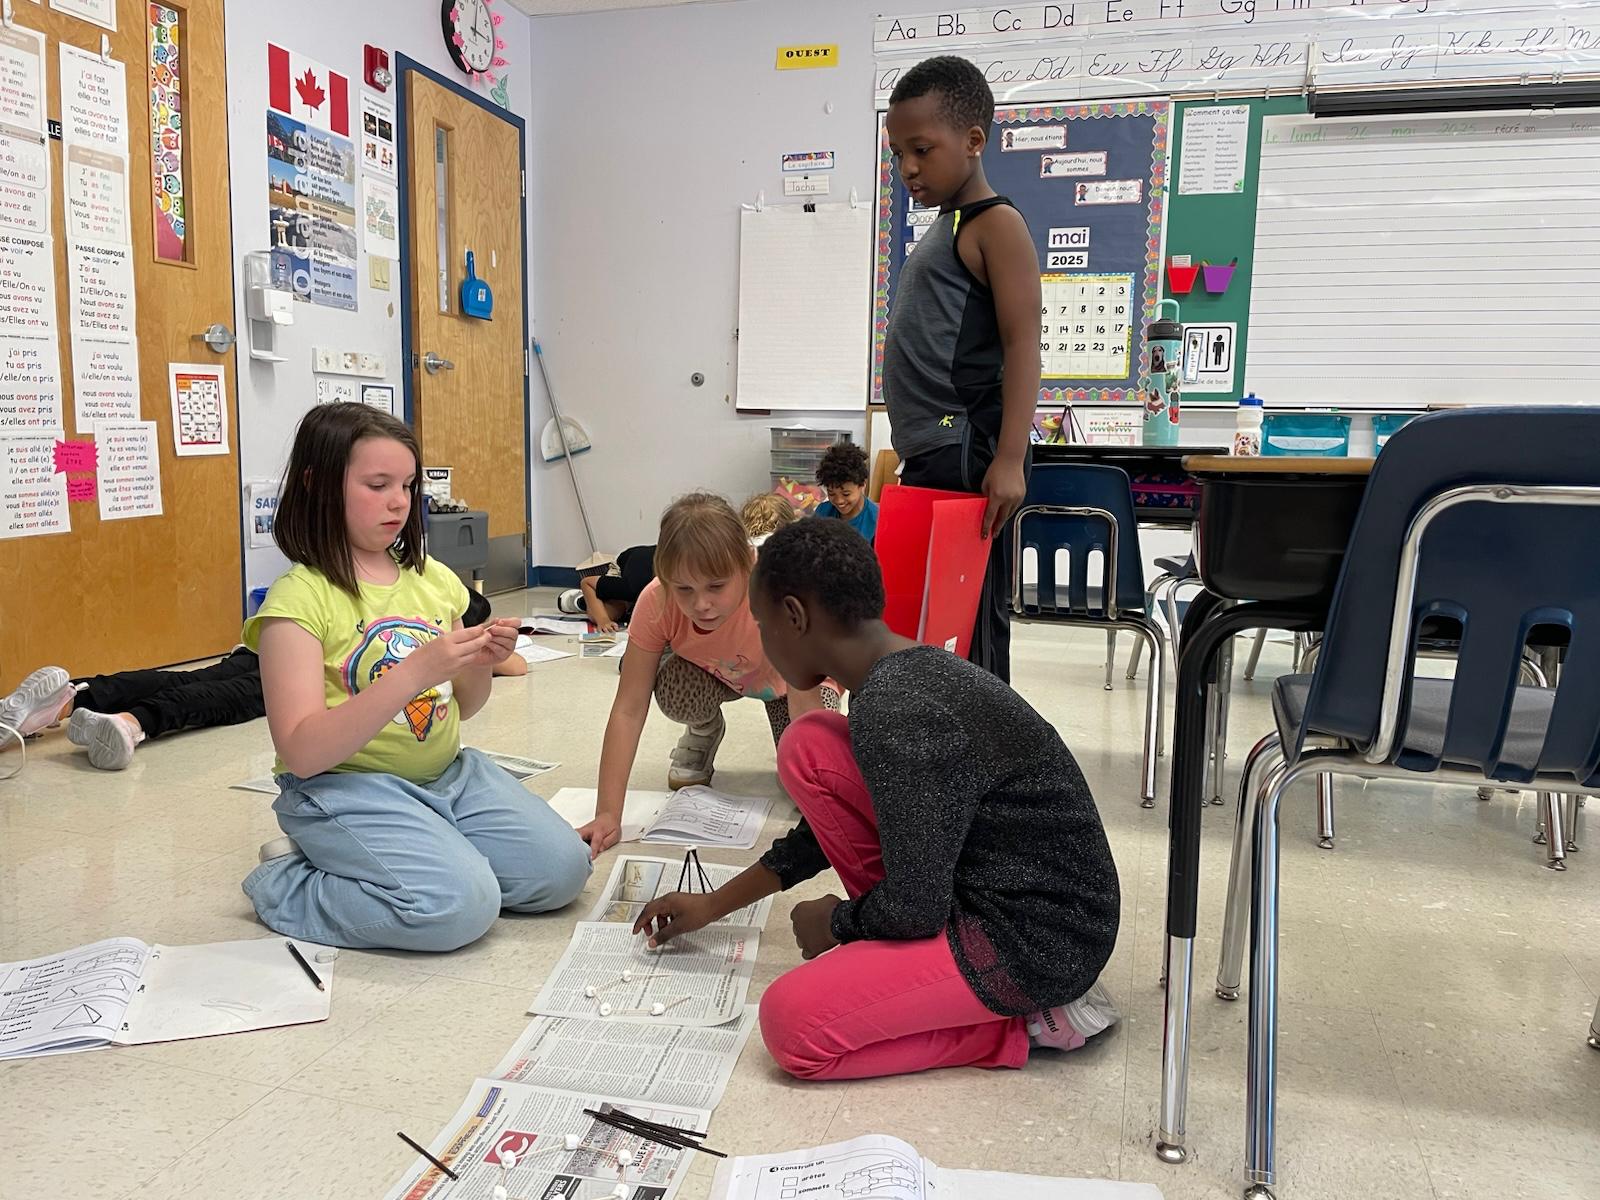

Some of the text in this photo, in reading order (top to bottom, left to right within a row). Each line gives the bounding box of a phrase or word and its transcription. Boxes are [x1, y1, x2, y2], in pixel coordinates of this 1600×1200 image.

[887, 19, 917, 40] Aa
[937, 14, 966, 36] Bb
[992, 10, 1022, 32] Cc
[1043, 4, 1074, 29] Dd
[1106, 0, 1133, 23] Ee
[786, 48, 830, 58] OUEST
[1052, 229, 1086, 245] mai
[1052, 256, 1083, 266] 2025
[80, 298, 96, 306] Nous
[1096, 326, 1105, 334] 16
[1112, 345, 1124, 354] 24
[22, 349, 37, 360] pris
[27, 362, 42, 371] pris
[336, 386, 352, 396] vous
[40, 394, 54, 402] pris
[38, 406, 52, 415] pris
[802, 1173, 826, 1181] arêtes
